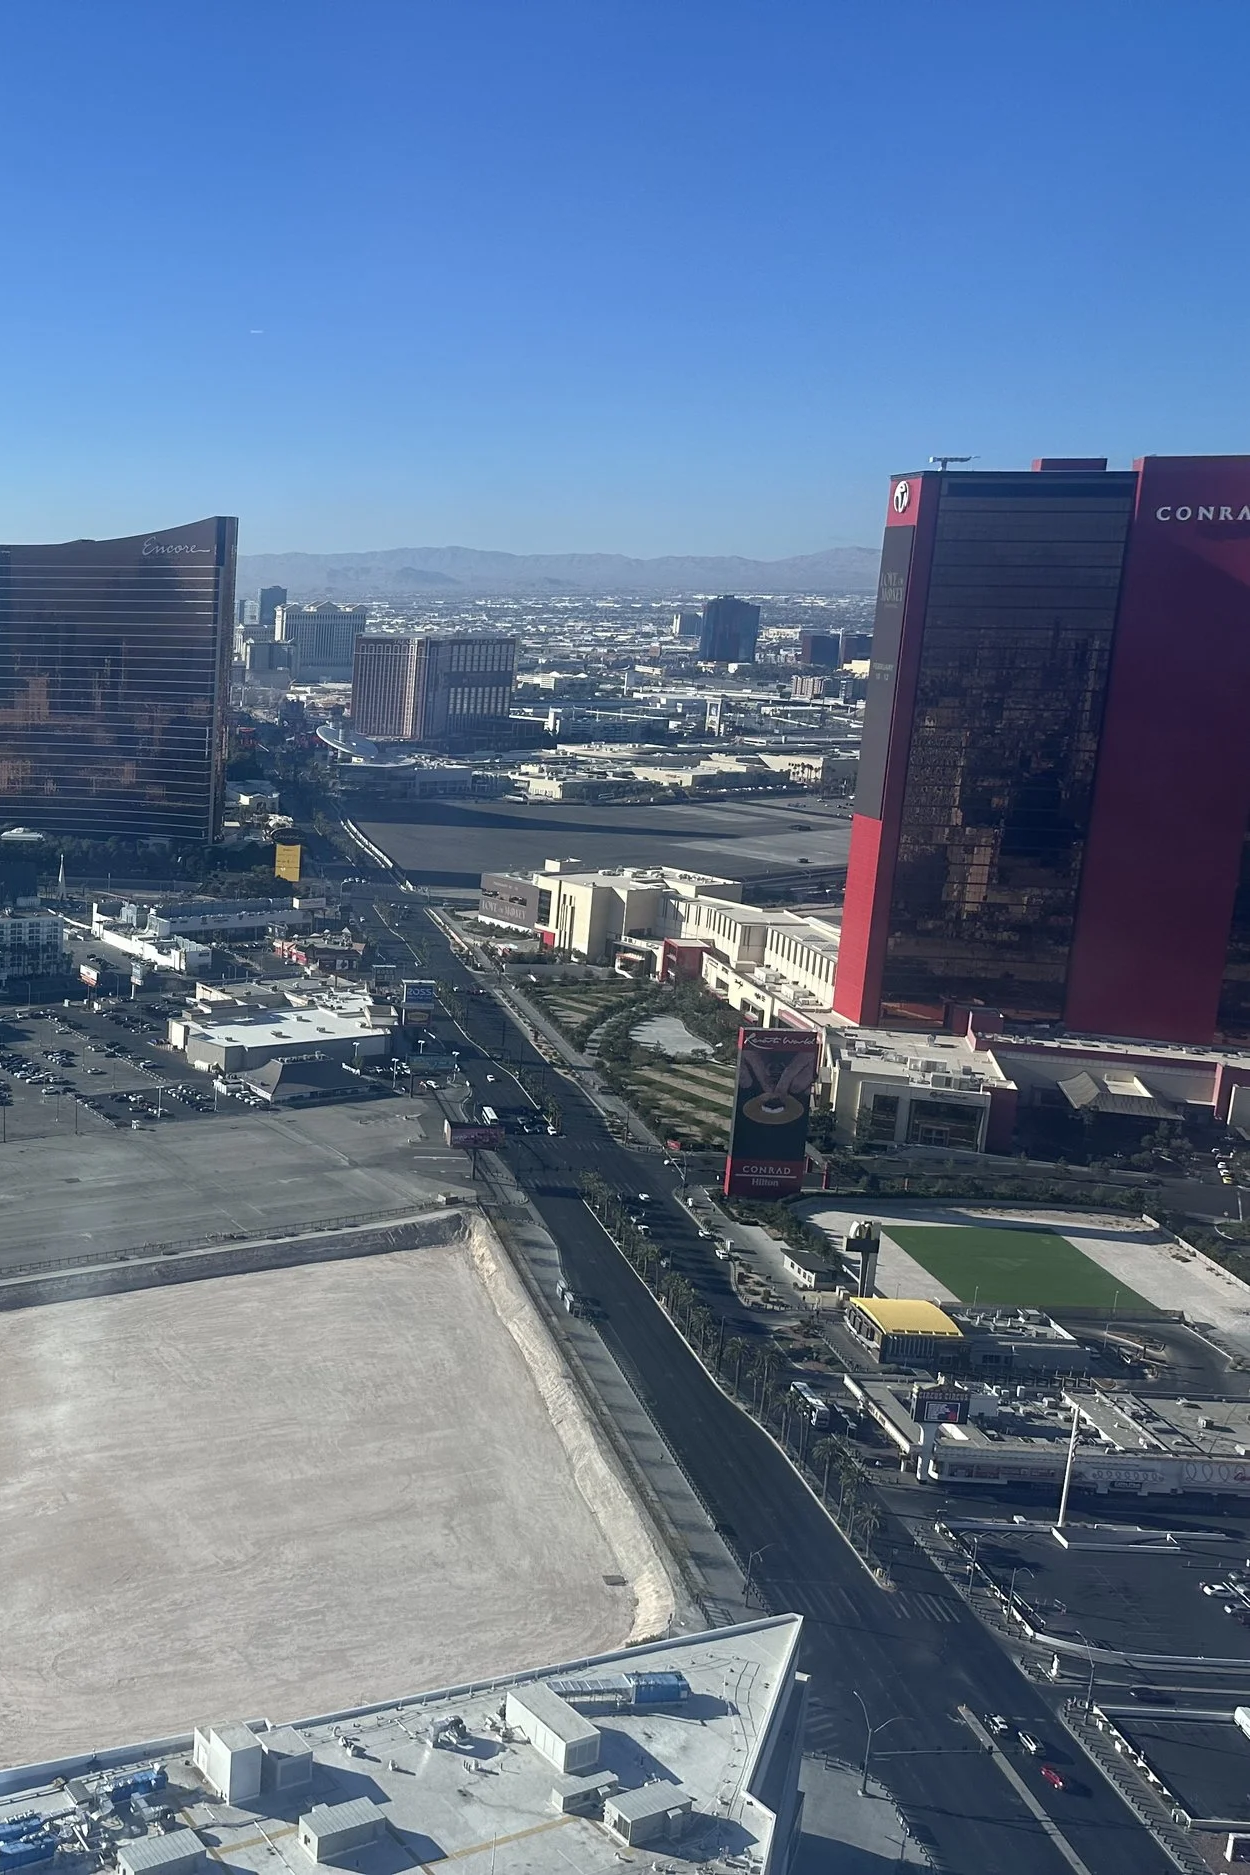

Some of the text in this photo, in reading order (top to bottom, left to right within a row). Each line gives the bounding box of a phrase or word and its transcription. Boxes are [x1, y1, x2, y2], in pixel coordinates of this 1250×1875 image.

[1154, 504, 1250, 522] CONRA
[141, 536, 210, 556] Encore
[742, 1165, 791, 1175] CONRAD
[751, 1178, 779, 1188] Hilton
[918, 1392, 969, 1401] CIRCUS CIRCUS
